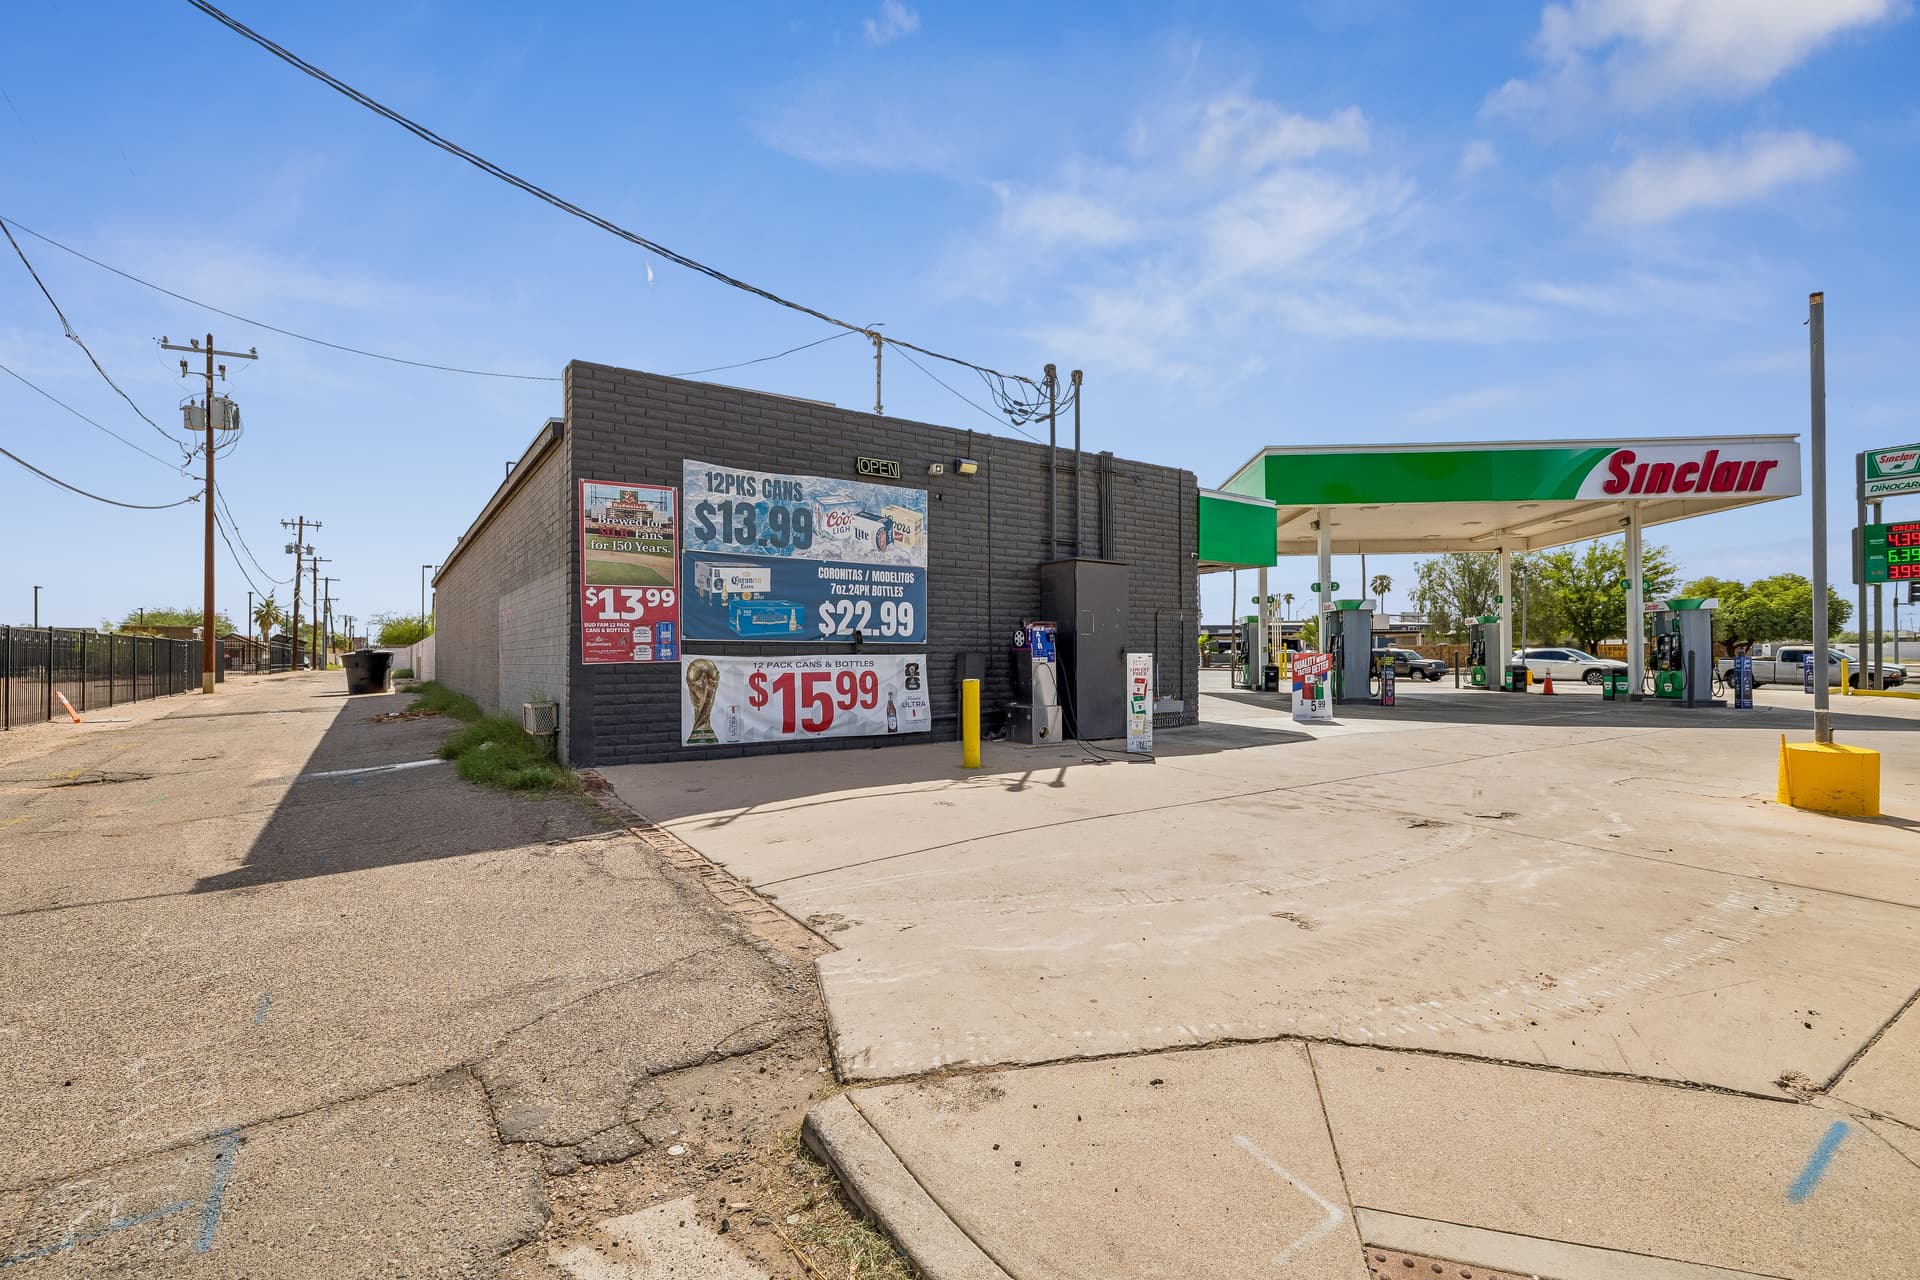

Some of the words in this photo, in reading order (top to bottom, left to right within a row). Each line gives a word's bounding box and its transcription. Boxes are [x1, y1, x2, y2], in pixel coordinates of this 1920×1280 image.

[1879, 452, 1917, 464] Sinclair
[860, 459, 898, 477] OPEN
[1602, 449, 1778, 495] Sinclair
[705, 471, 756, 497] 12PKS
[762, 478, 803, 502] CANS
[598, 514, 643, 527] Brewed
[647, 517, 664, 528] for
[694, 500, 813, 550] $13.99
[599, 527, 629, 538] MLB
[635, 529, 664, 540] Fans
[833, 526, 851, 535] LIGH
[590, 539, 609, 550] for
[612, 540, 632, 552] 150
[635, 542, 671, 553] Years.
[818, 567, 863, 581] CORONITAS
[871, 570, 915, 584] MODELITOS
[871, 585, 904, 598] BOTTLES
[818, 599, 914, 637] $22.99
[766, 661, 794, 669] PACK
[796, 661, 823, 669] CANS
[825, 660, 833, 668] &
[835, 660, 875, 668] BOTTLES
[1294, 655, 1316, 672] QUALITY
[1311, 660, 1329, 675] BETTER
